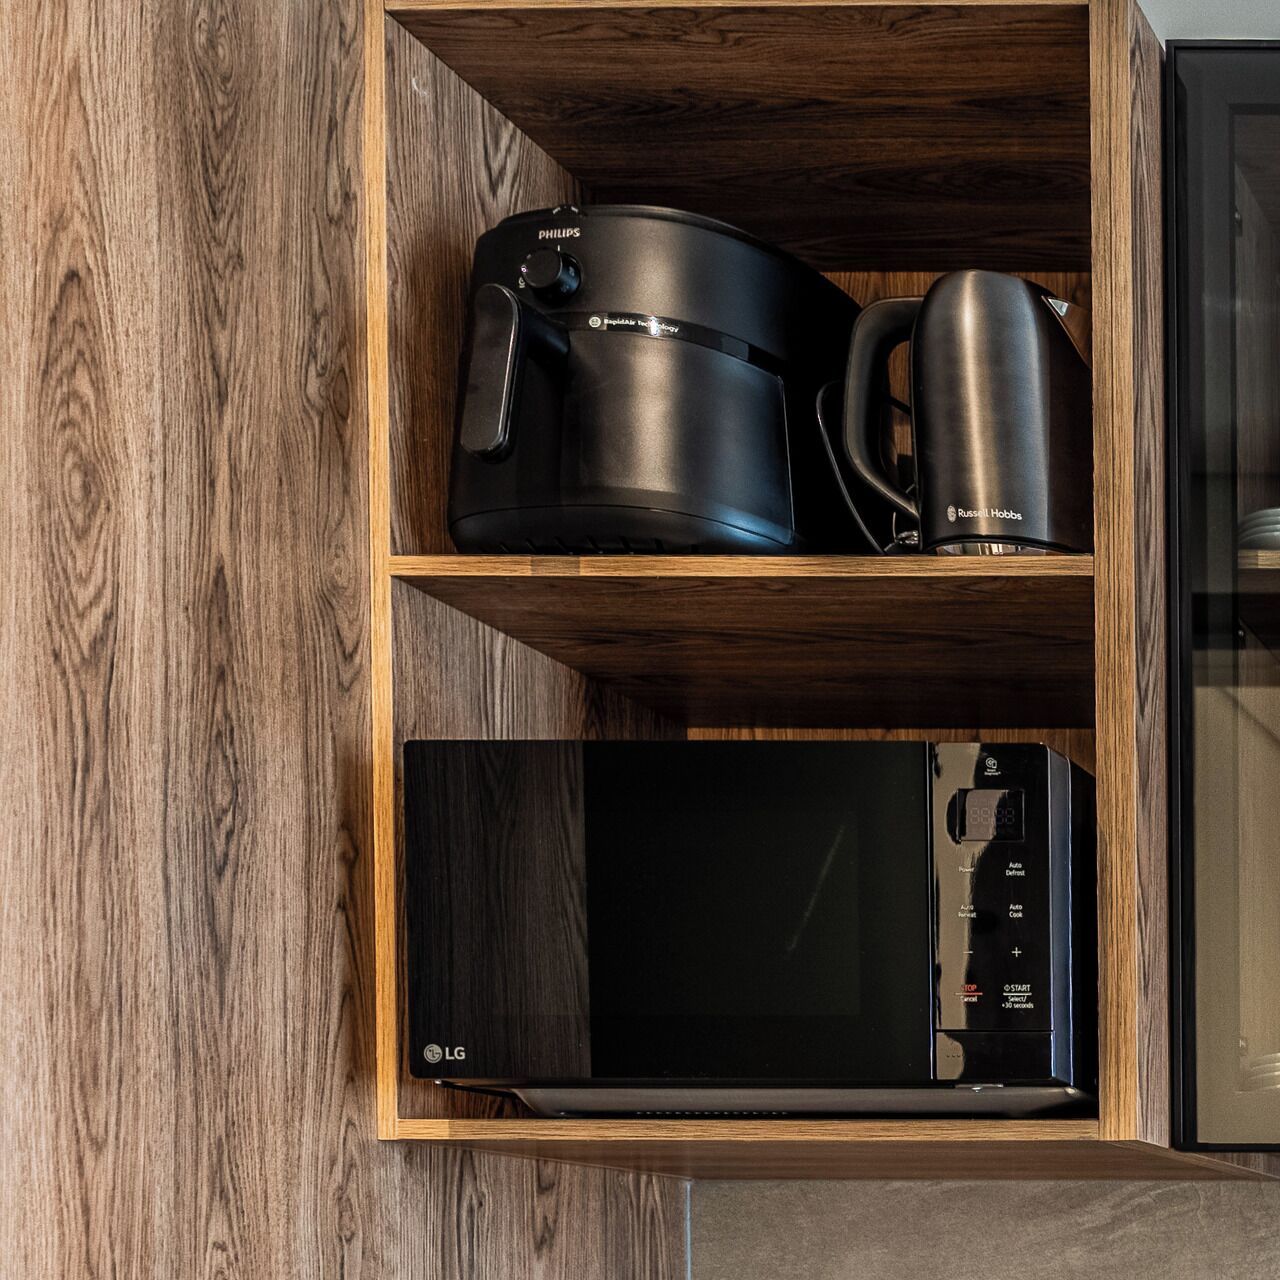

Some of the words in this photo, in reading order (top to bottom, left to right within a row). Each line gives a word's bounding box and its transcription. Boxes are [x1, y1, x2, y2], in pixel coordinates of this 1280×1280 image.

[538, 227, 581, 240] PHILIPS
[603, 318, 636, 326] RapidAir
[958, 508, 989, 518] Russell
[991, 508, 1022, 520] Hobbs
[1010, 984, 1031, 992] START
[445, 1046, 466, 1060] LG
